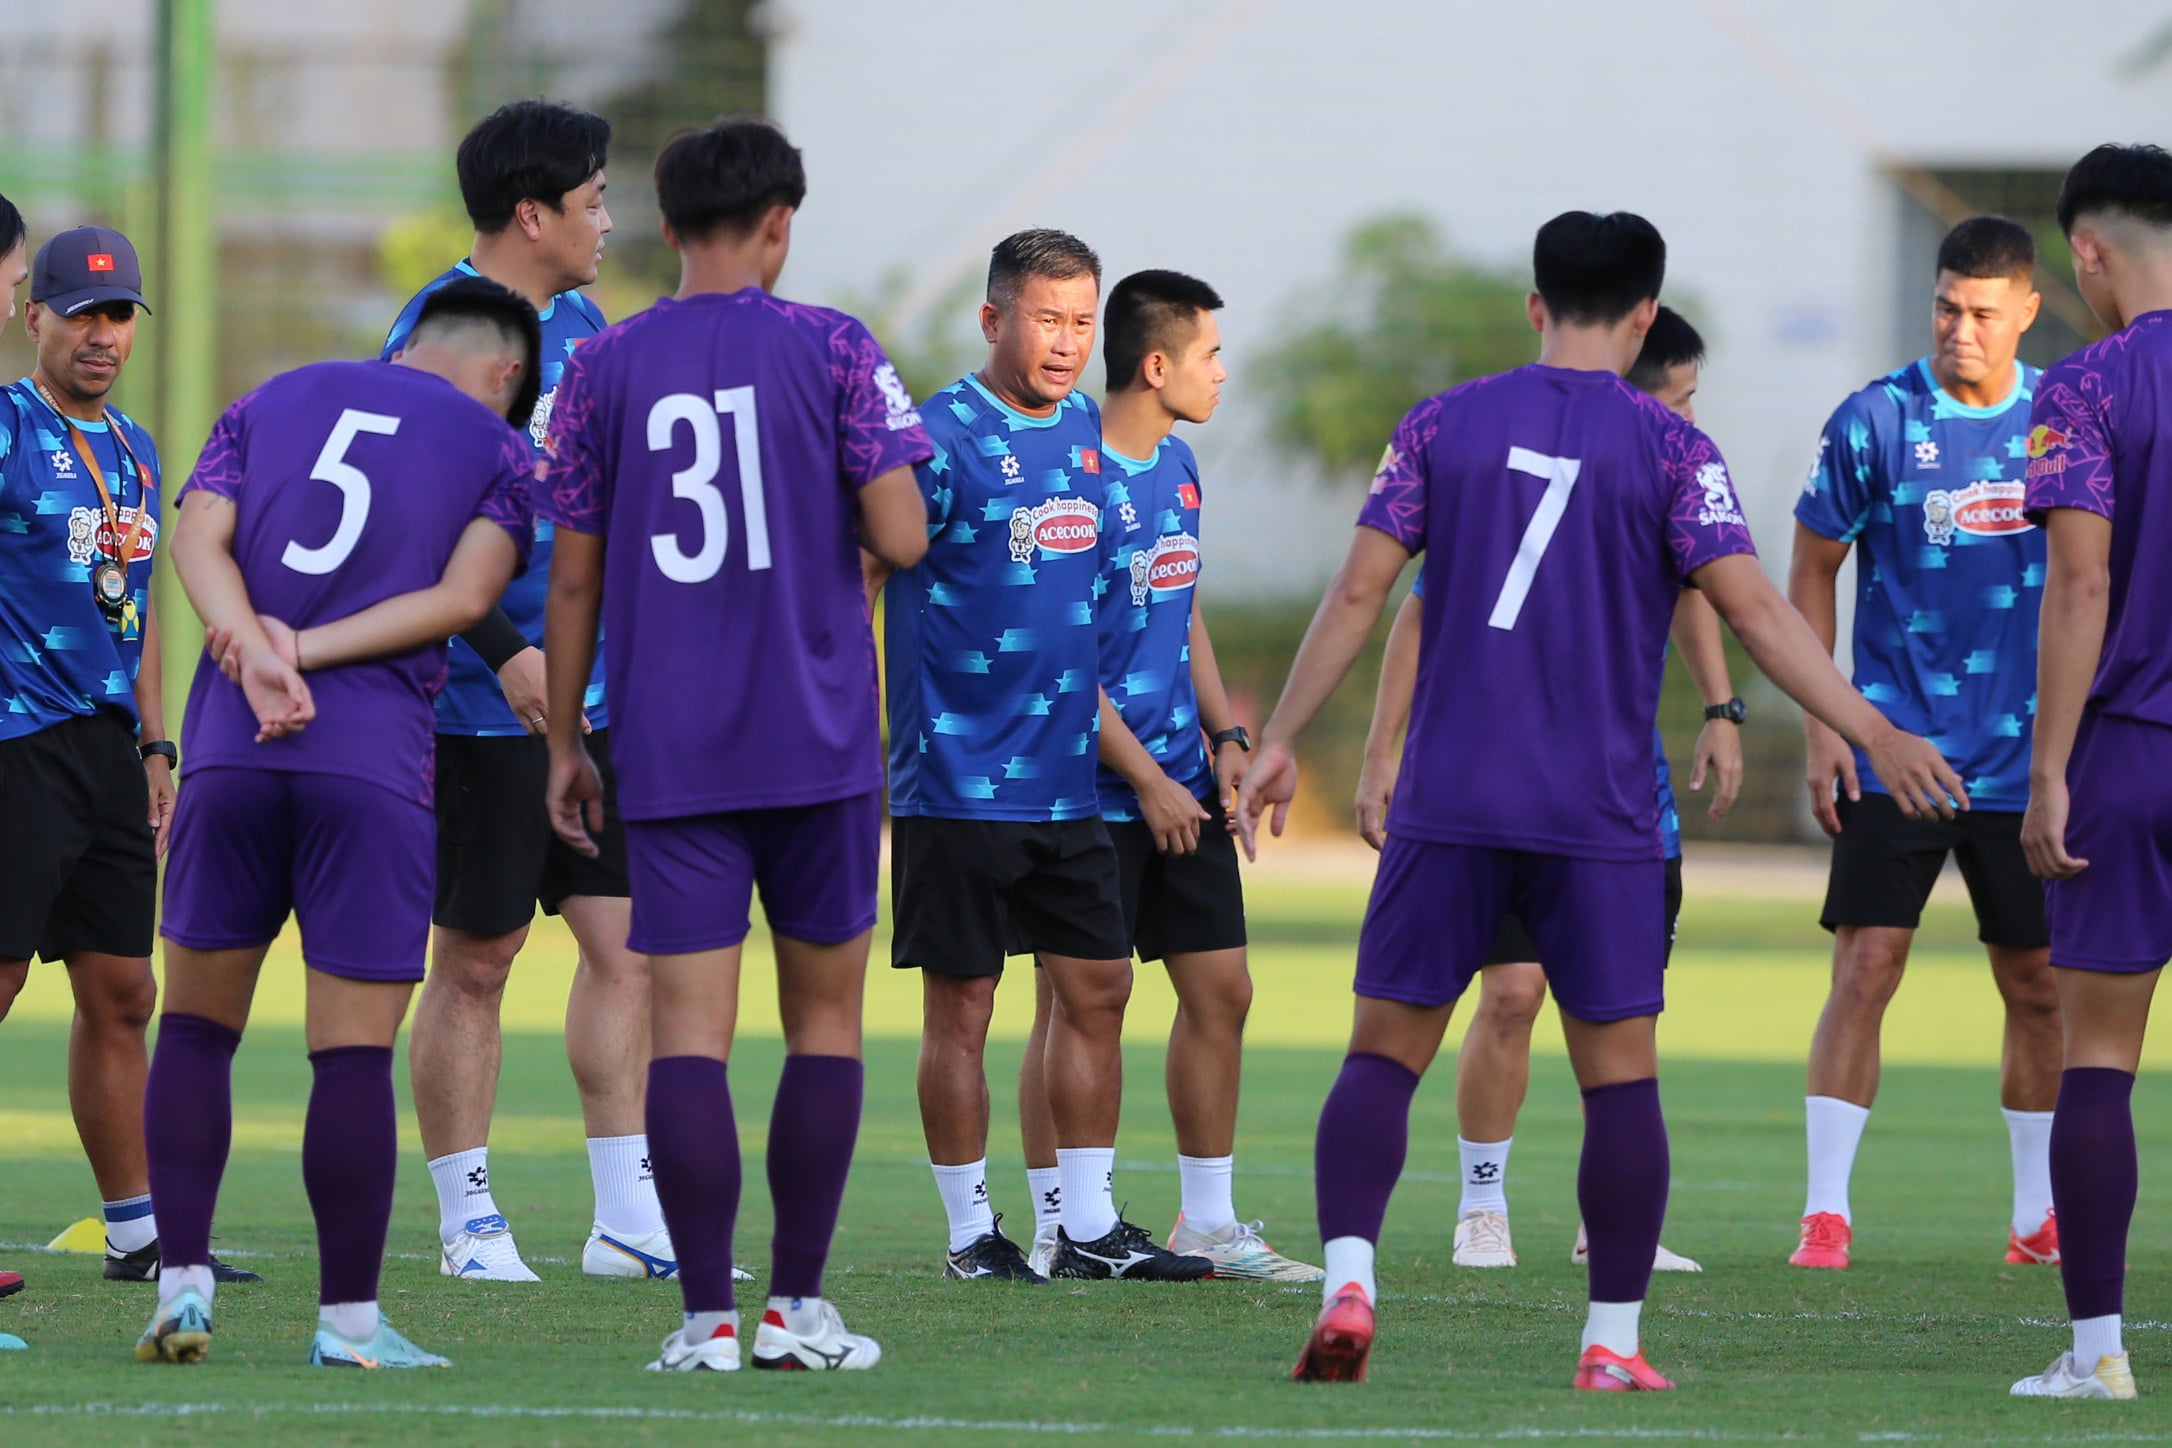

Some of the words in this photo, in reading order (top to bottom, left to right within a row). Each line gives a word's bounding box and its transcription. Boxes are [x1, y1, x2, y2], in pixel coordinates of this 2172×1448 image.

[279, 408, 402, 575] 5
[647, 385, 772, 583] 31
[1032, 500, 1056, 520] Cook
[1056, 498, 1098, 517] happiness
[1488, 446, 1582, 631] 7
[2038, 453, 2066, 476] Bull
